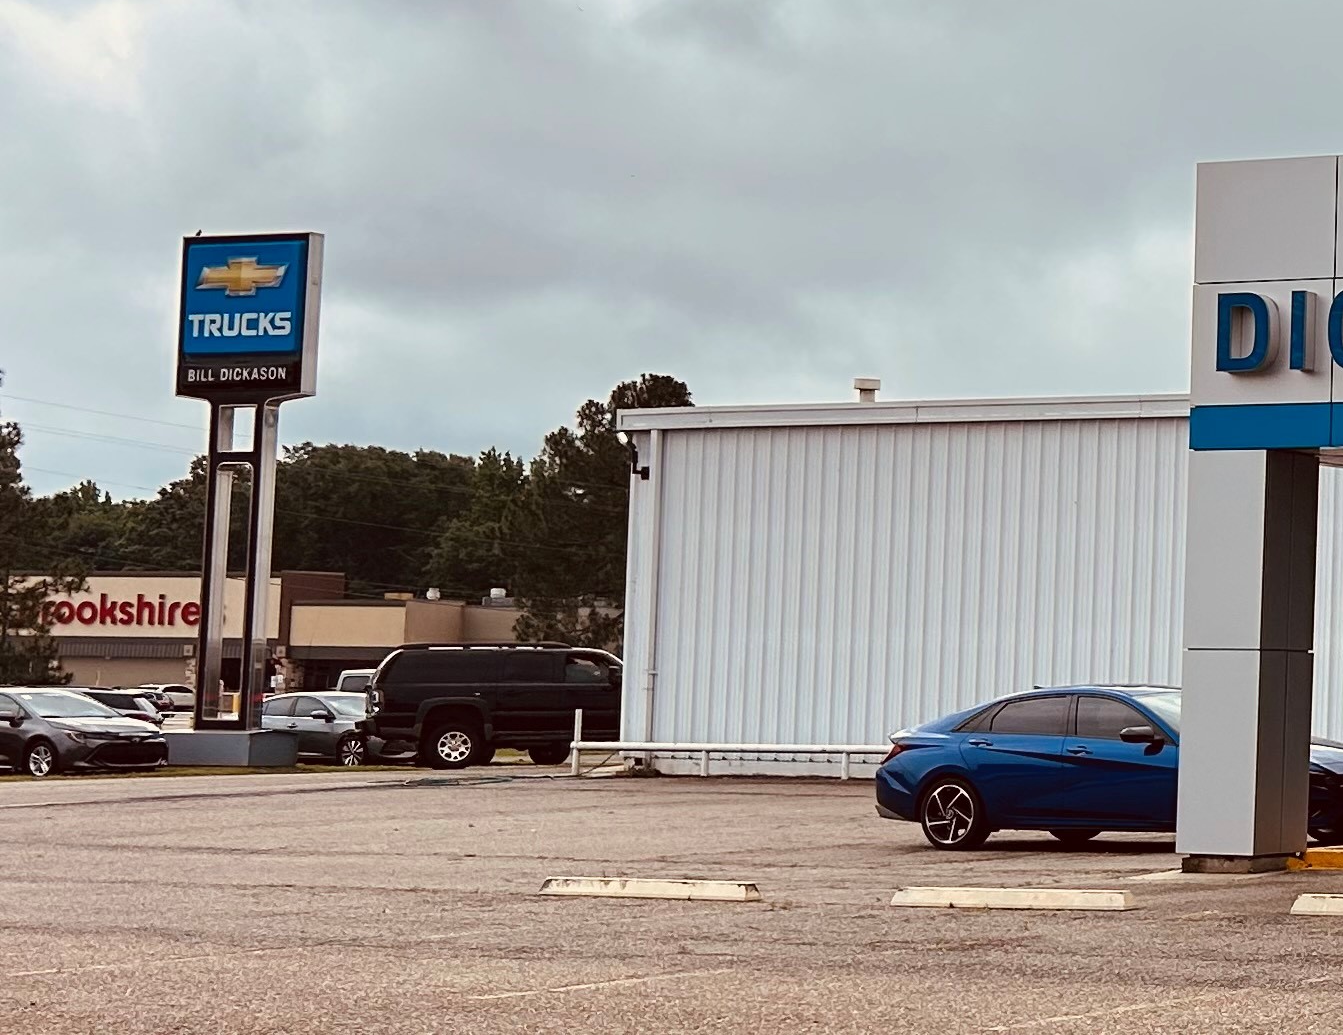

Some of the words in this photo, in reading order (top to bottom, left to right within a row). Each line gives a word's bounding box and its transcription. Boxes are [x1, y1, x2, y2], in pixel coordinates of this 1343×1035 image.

[188, 311, 292, 337] TRUCKS
[187, 368, 215, 382] BILL
[220, 366, 287, 381] DICKASON
[42, 592, 201, 626] rookshire
